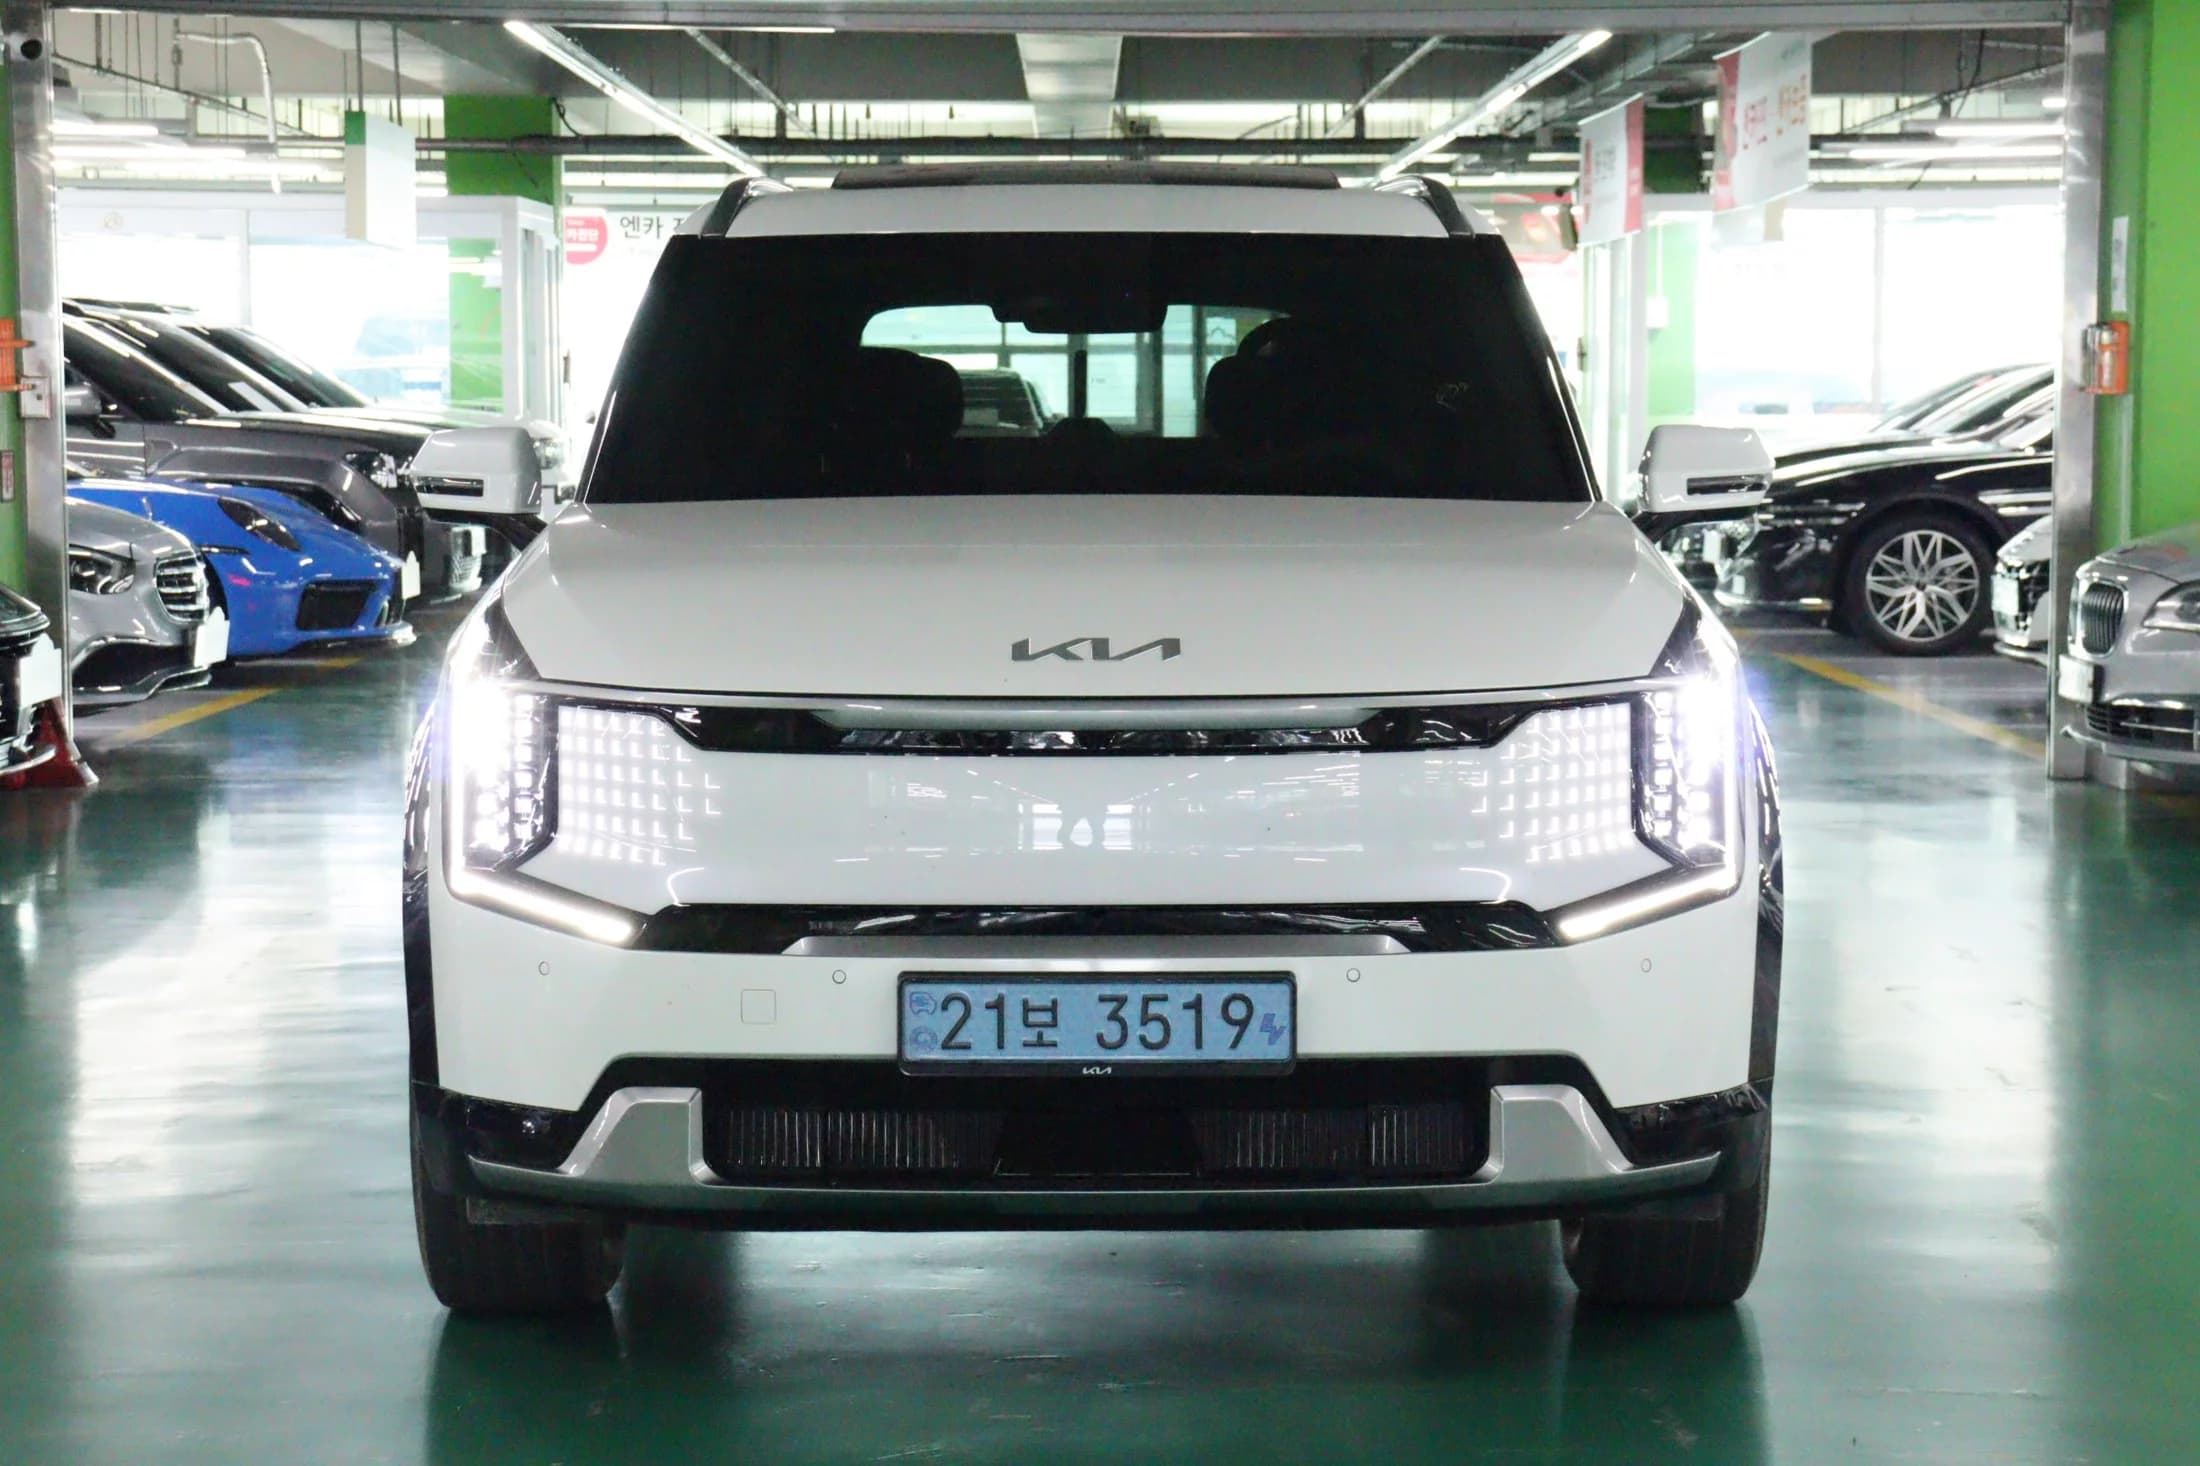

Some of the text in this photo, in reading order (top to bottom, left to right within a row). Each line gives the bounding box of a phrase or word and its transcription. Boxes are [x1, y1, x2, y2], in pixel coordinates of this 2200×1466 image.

[620, 215, 664, 240] 엔카
[1011, 637, 1181, 662] KIA
[941, 992, 1255, 1050] 21보 3519
